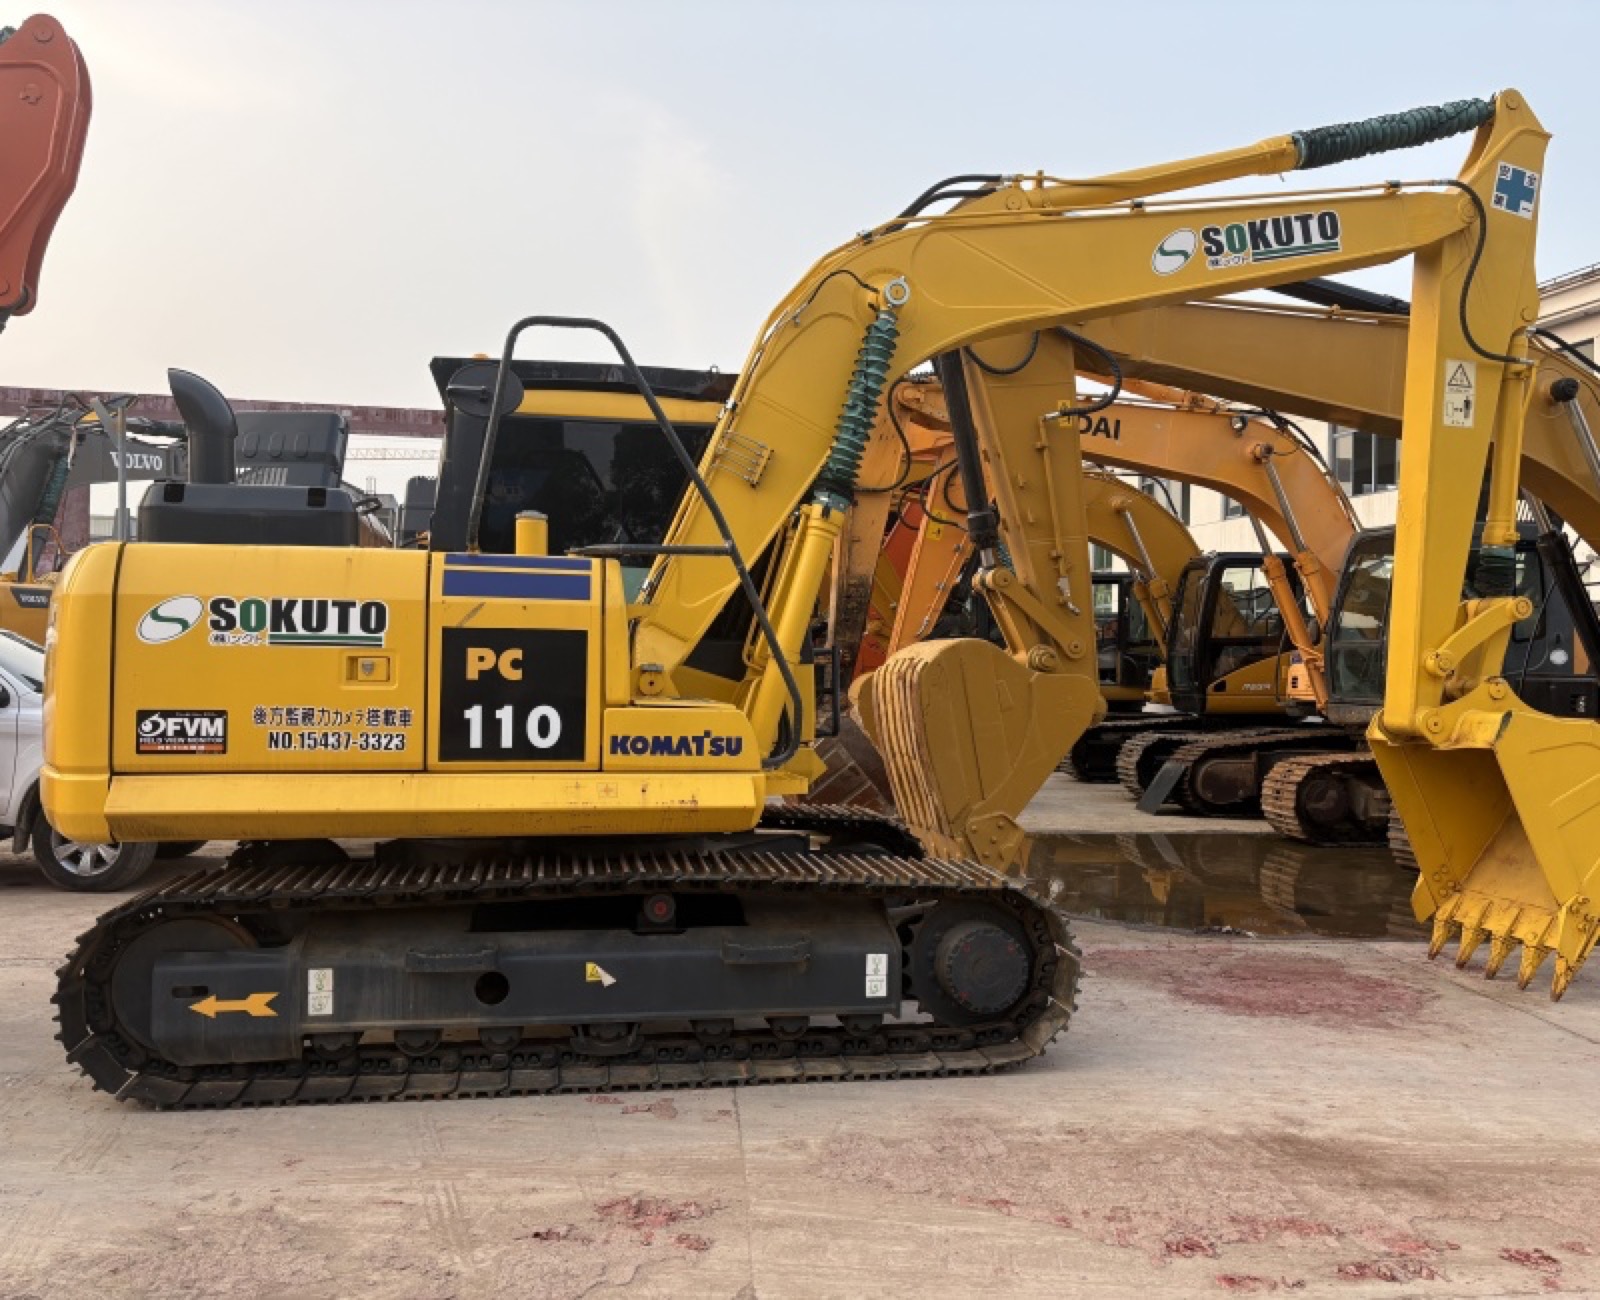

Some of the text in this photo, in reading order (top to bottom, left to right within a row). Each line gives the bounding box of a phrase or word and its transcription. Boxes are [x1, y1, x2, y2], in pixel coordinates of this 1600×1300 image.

[1201, 211, 1339, 257] SOKUTO
[209, 597, 387, 634] SOKUTO
[465, 647, 523, 681] PC
[166, 717, 224, 737] FVM
[268, 731, 406, 751] NO.15437-3323
[463, 704, 563, 749] 110
[609, 730, 743, 757] KOMATSU
